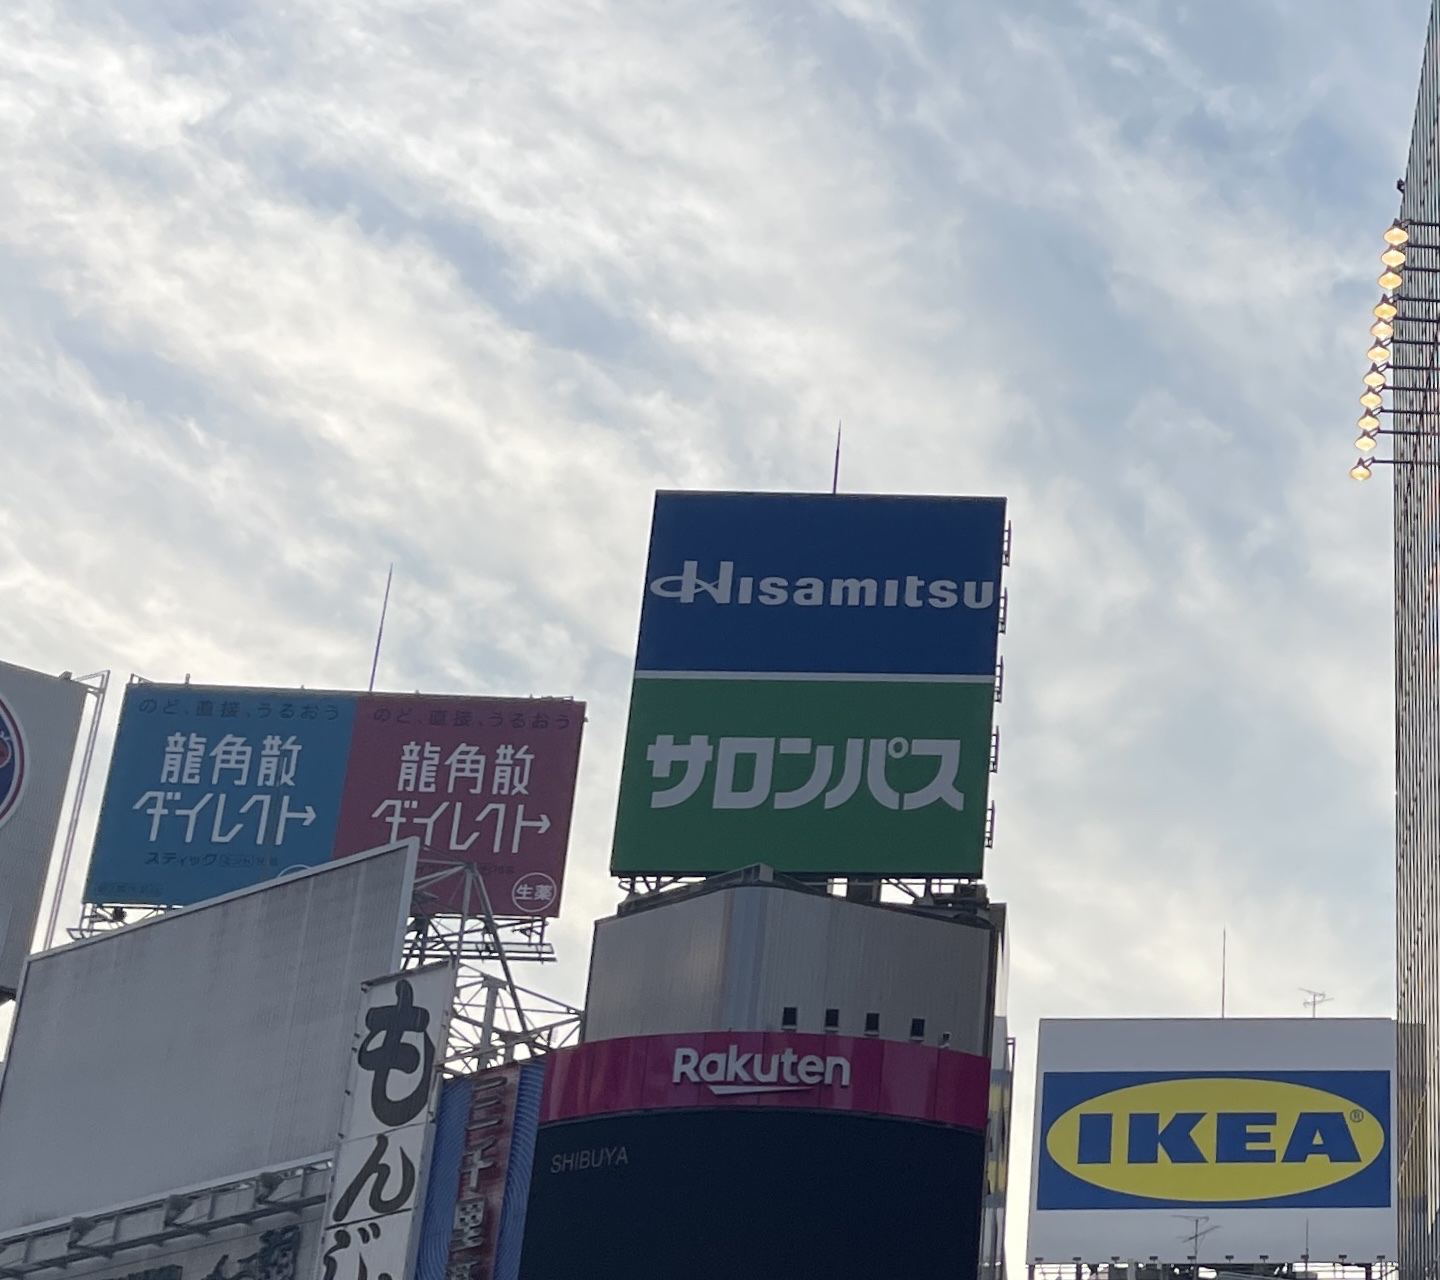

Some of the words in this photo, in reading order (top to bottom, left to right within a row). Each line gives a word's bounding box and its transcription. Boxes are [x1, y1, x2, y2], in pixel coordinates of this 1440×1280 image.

[649, 560, 994, 609] Hisamitsu
[138, 698, 340, 721] のど、直接、うるおう
[372, 706, 571, 730] のど、直接、うるおう
[160, 731, 303, 788] 龍角散
[397, 741, 536, 796] 龍角散
[646, 733, 965, 811] サロンパス
[132, 790, 318, 846] ダイレクト
[371, 799, 551, 854] ダイレクト
[515, 883, 554, 901] 生薬
[671, 1045, 851, 1088] Rakuten
[550, 1147, 629, 1174] SHIBUYA
[1077, 1111, 1362, 1164] IKEA
